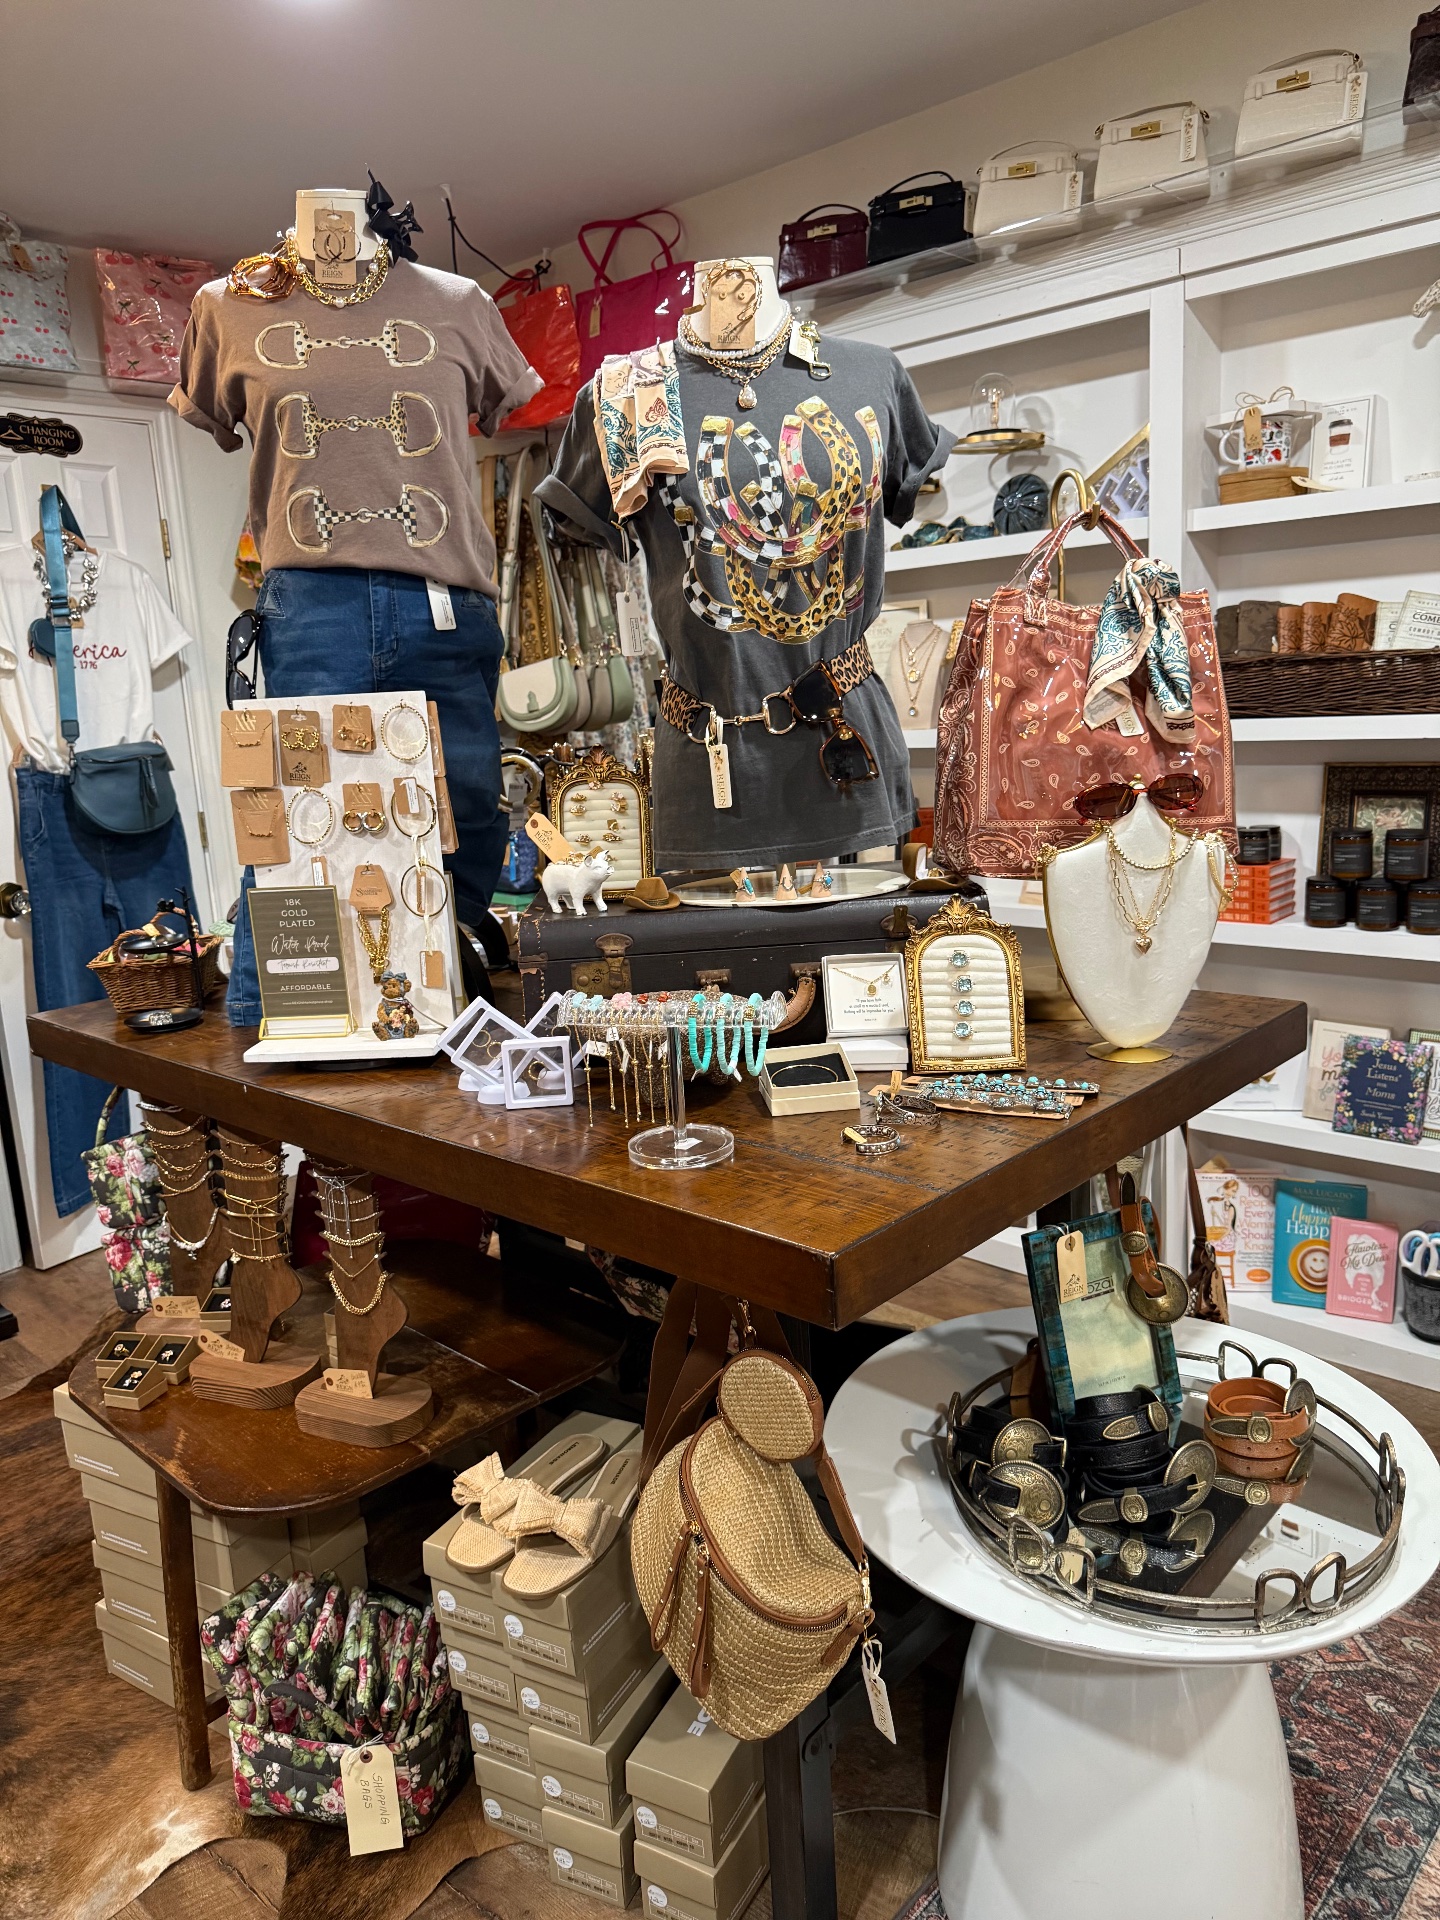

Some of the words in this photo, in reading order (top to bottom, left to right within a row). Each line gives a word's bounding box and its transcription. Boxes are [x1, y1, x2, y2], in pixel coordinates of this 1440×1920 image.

[1351, 93, 1360, 119] REIGN
[321, 269, 344, 277] REIGN
[19, 424, 75, 440] CHANGING
[33, 435, 65, 447] ROOM
[79, 660, 98, 670] 1776
[289, 772, 312, 780] REIGN
[717, 773, 727, 807] REIGN
[284, 898, 302, 906] 18K
[281, 909, 308, 917] GOLD
[279, 919, 316, 928] PLATED
[280, 983, 332, 992] AFFORDABLE
[1371, 1058, 1397, 1071] Jesus
[1365, 1086, 1396, 1100] Moms
[1247, 1184, 1272, 1198] 100
[1316, 1189, 1353, 1199] LUCADO
[1244, 1207, 1274, 1219] Every
[1310, 1204, 1340, 1216] HOW
[1239, 1218, 1275, 1228] Woma
[1286, 1219, 1330, 1240] Happ
[1244, 1240, 1273, 1250] Know
[1340, 1255, 1361, 1270] My
[1087, 1273, 1115, 1294] ozai
[1063, 1284, 1084, 1296] REIGN
[1337, 1293, 1389, 1308] BRIDGERON
[610, 1458, 631, 1485] LEMONADE
[360, 1779, 373, 1809] BAGS
[372, 1772, 391, 1825] SHOPPING
